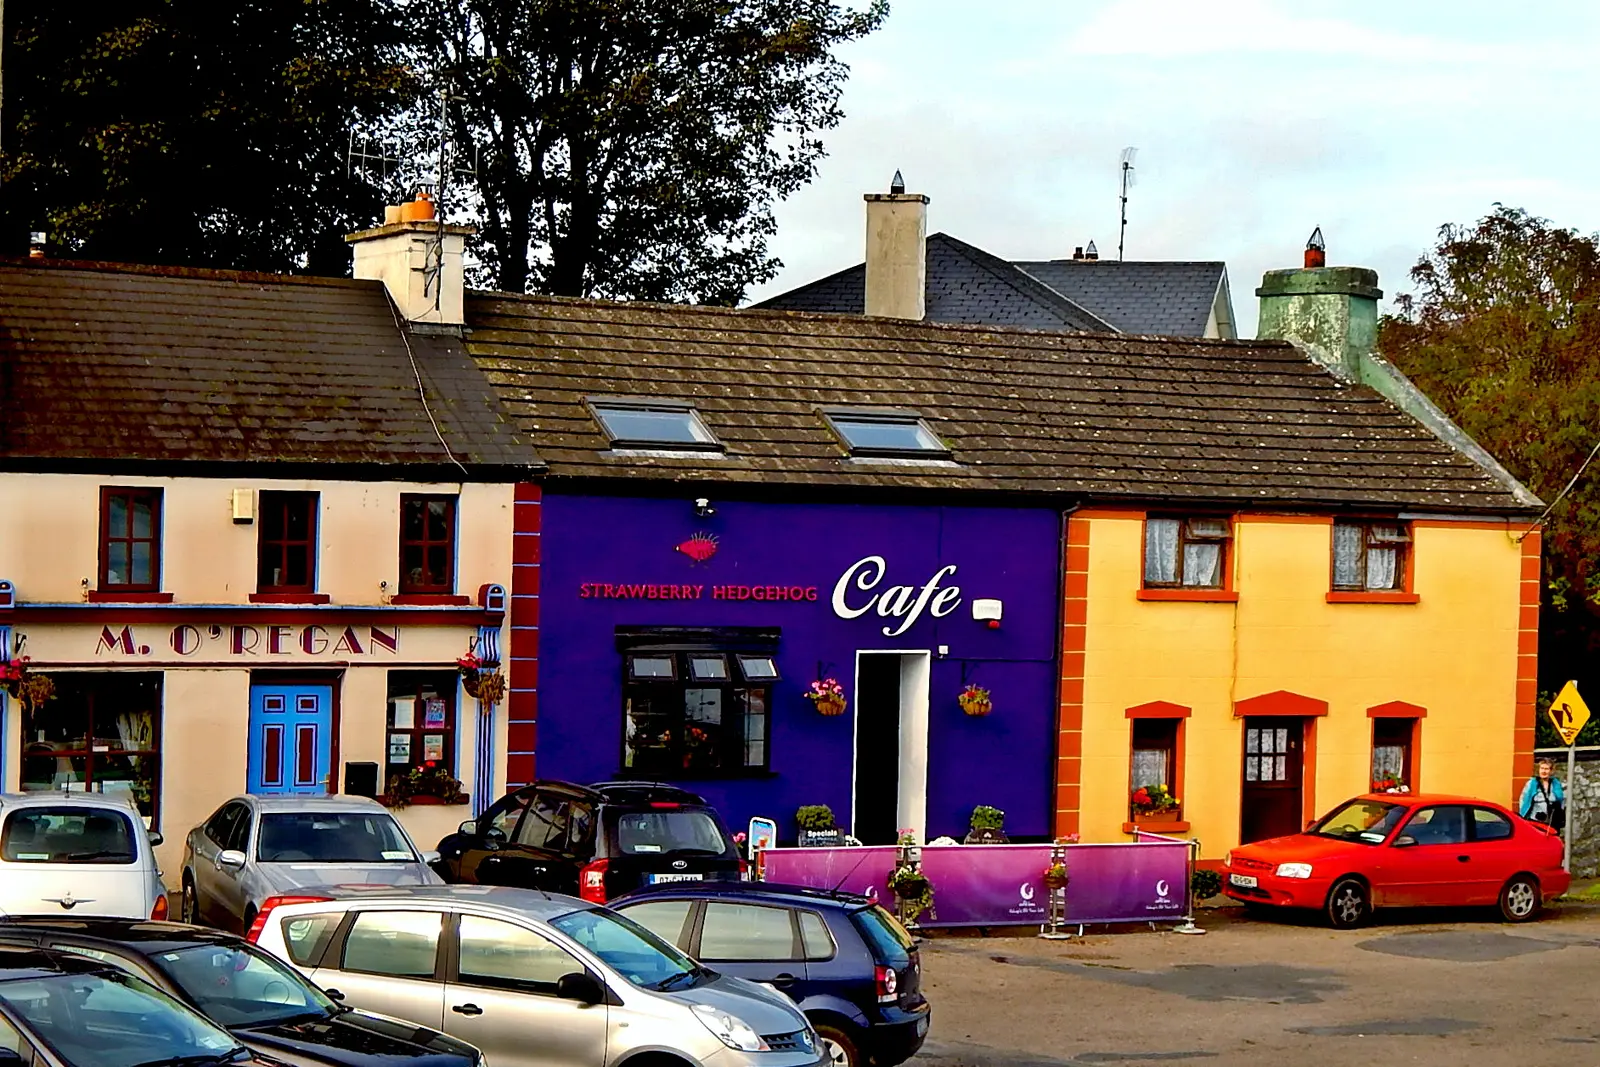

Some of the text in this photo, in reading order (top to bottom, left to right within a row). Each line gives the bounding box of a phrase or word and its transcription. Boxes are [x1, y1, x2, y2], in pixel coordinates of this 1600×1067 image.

[580, 583, 818, 601] STRAWBERRY HEDGEHOG
[832, 555, 962, 637] Cafe
[95, 624, 400, 656] M. O'REGAN
[807, 829, 838, 838] Specials
